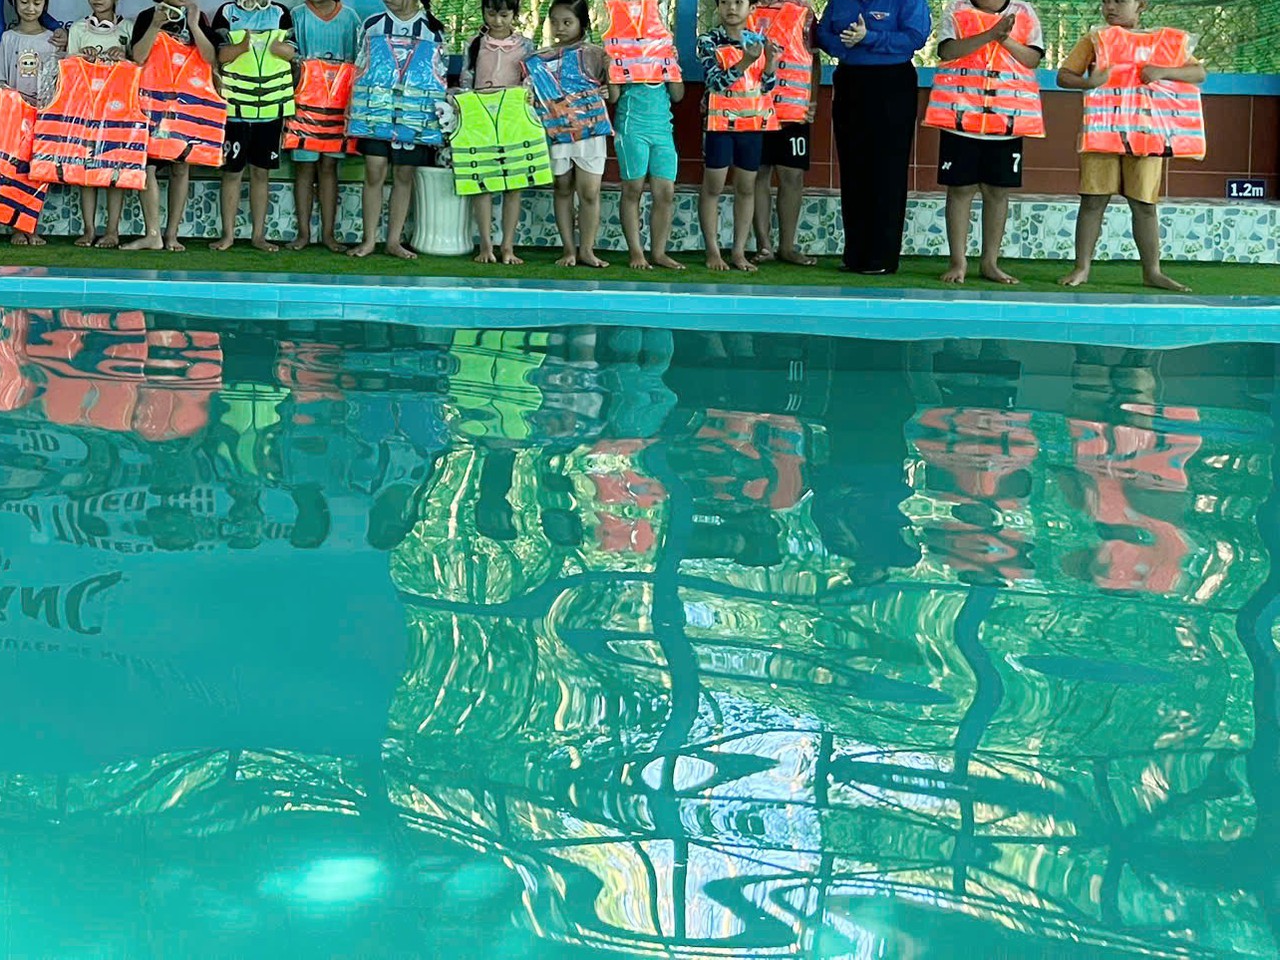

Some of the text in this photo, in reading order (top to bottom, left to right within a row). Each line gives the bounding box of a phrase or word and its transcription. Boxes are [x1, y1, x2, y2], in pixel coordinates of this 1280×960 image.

[789, 136, 806, 156] 10
[1012, 152, 1021, 173] 7
[1230, 182, 1264, 197] 1.2m
